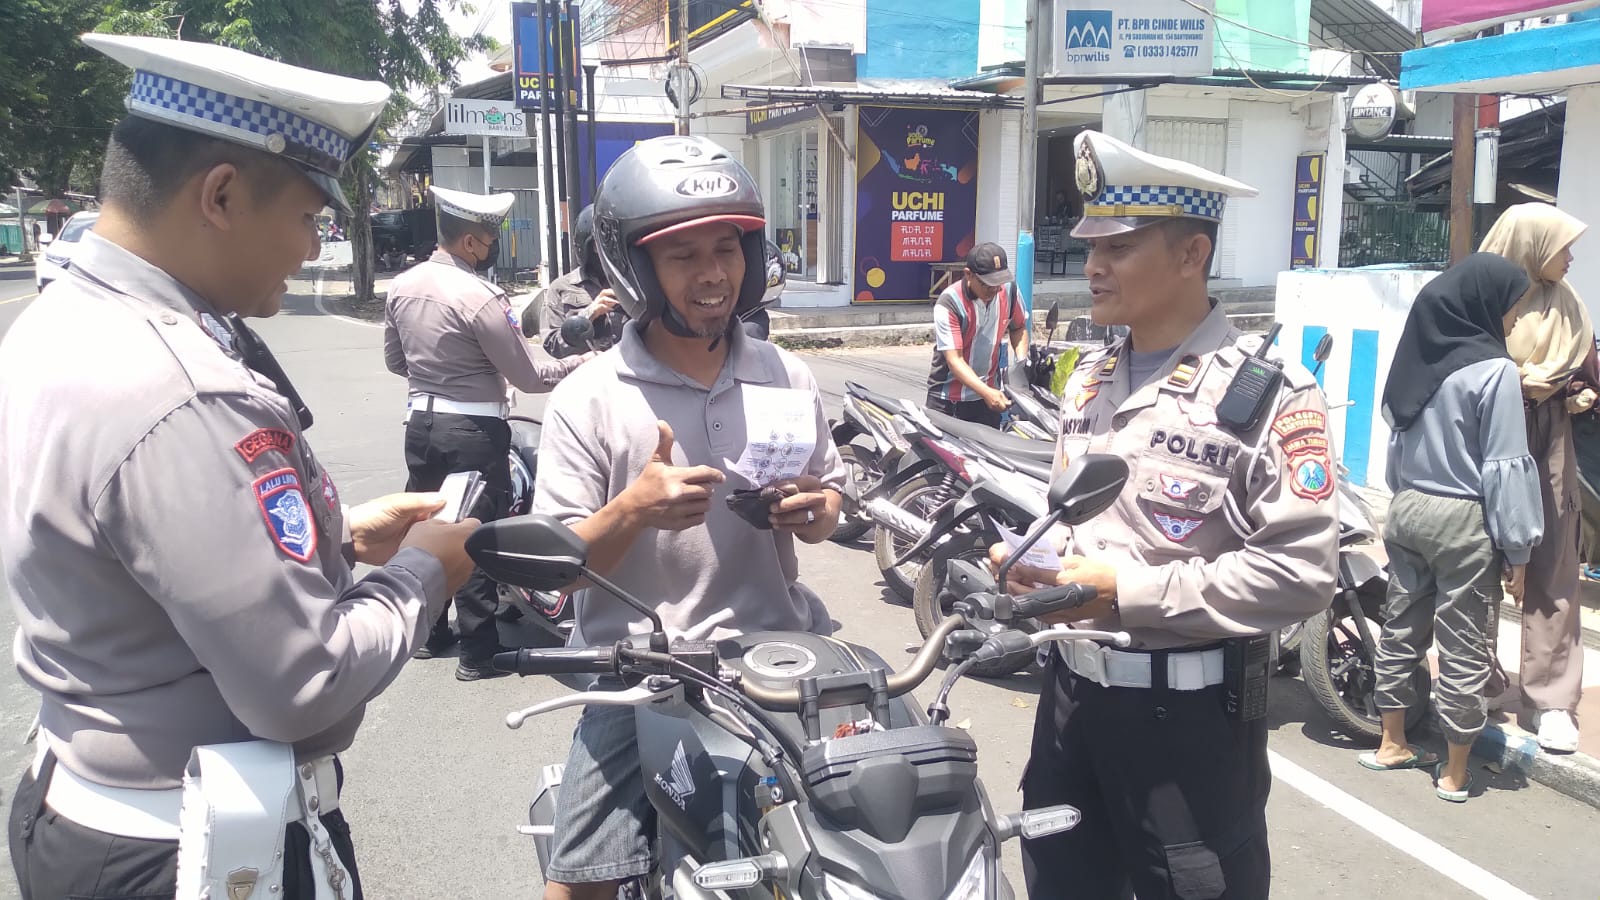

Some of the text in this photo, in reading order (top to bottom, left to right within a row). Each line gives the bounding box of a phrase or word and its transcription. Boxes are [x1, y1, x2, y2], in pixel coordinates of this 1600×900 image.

[1118, 19, 1205, 30] PT. BPR CINDE WILIS
[1170, 45, 1198, 57] 425777
[1067, 51, 1110, 64] bprwilis
[520, 77, 555, 89] UCI
[1353, 107, 1389, 118] BINTANG
[892, 191, 945, 210] UCHI
[891, 210, 944, 221] PARFUME
[900, 225, 935, 234] ADA DI
[902, 236, 932, 246] MANA
[902, 248, 932, 257] MANA
[1274, 411, 1322, 429] POLRESTA
[242, 432, 290, 454] GEGANA
[1150, 430, 1230, 466] POLRI
[259, 476, 282, 495] LALU
[653, 772, 686, 811] HONDA
